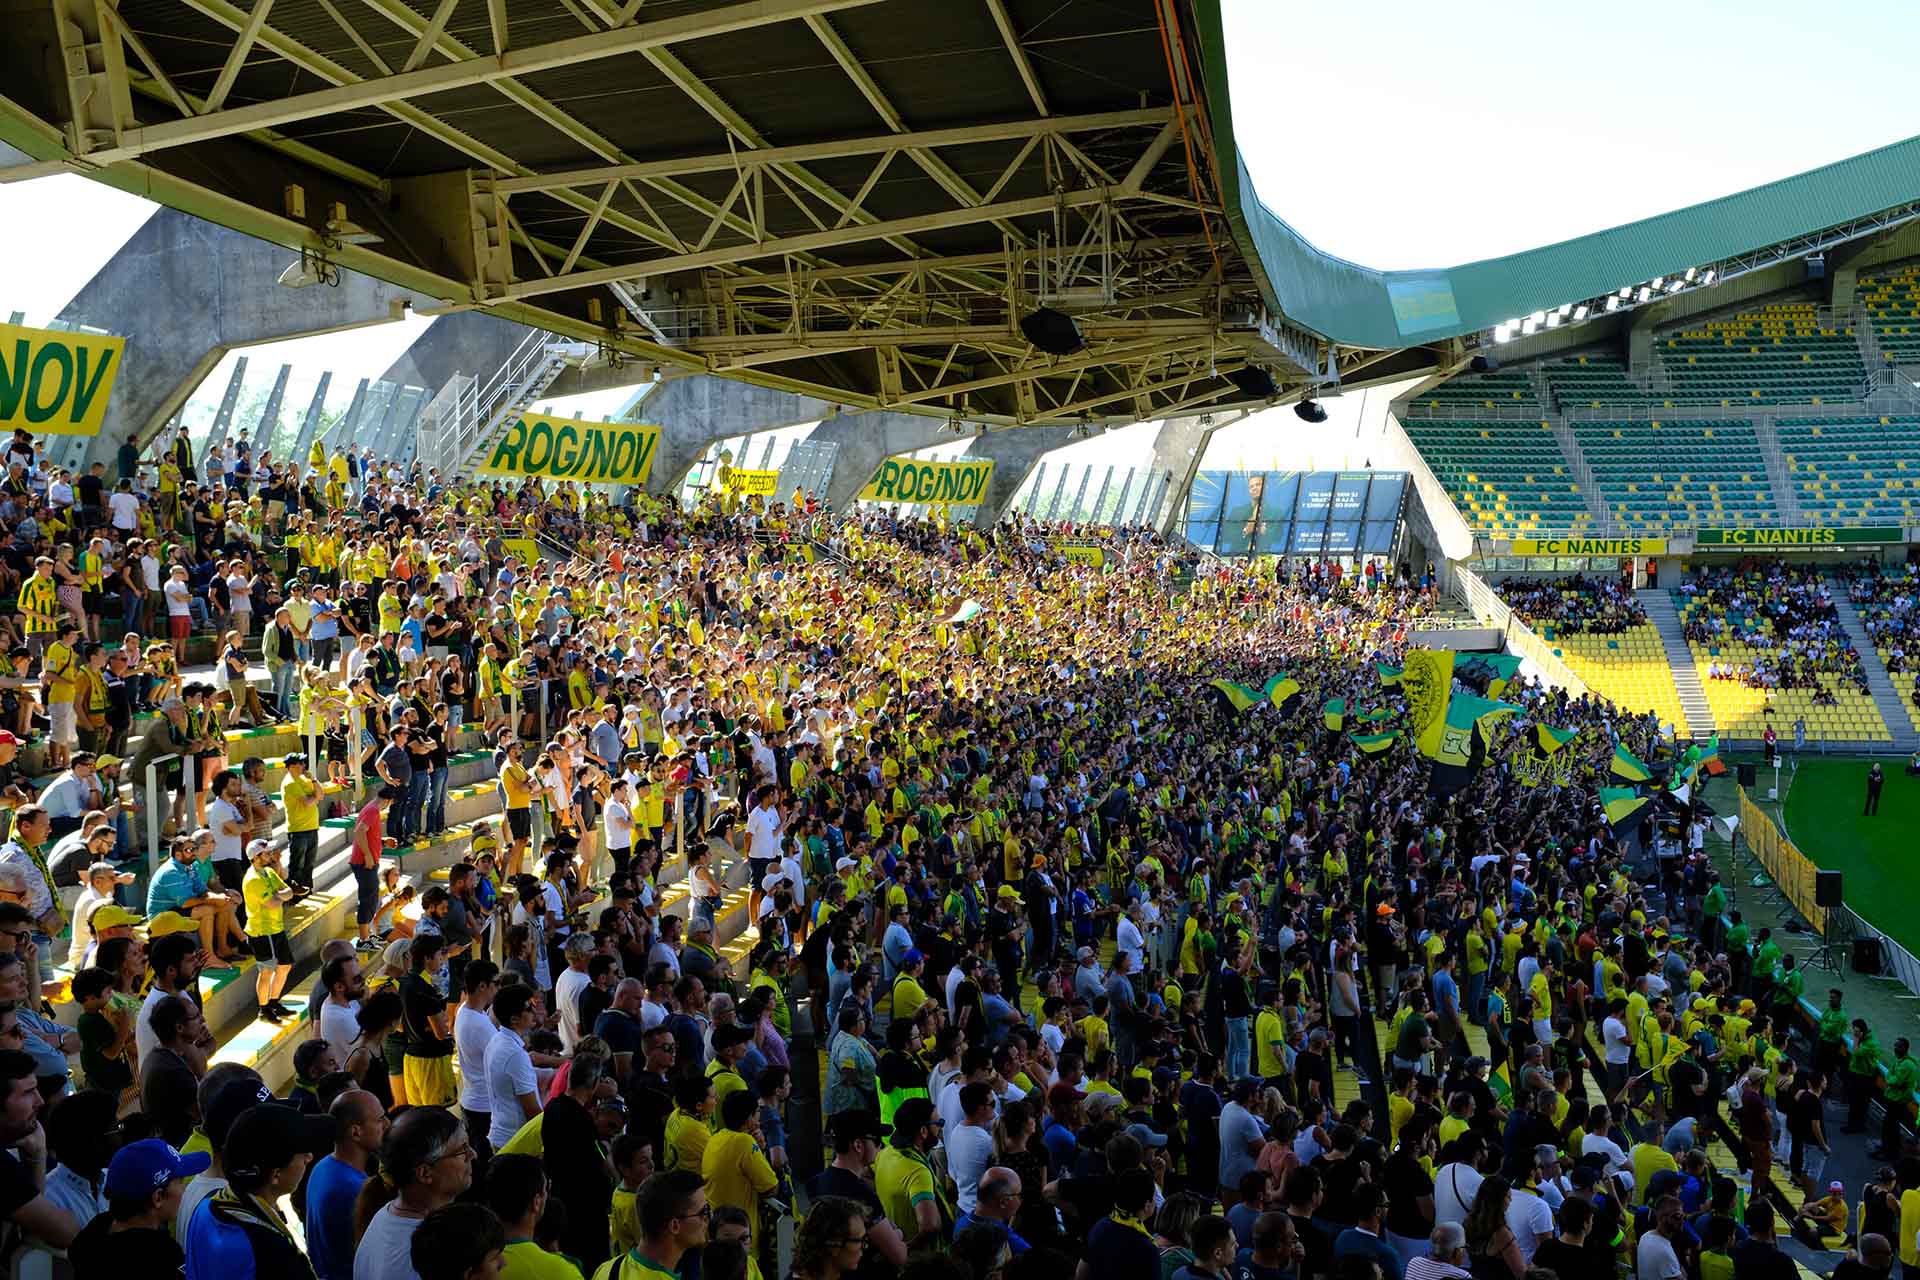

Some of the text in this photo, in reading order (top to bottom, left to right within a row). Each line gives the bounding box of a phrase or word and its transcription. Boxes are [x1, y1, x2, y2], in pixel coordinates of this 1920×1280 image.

[1722, 529, 1836, 544] FC NANTES
[1536, 540, 1642, 554] FC NANTES
